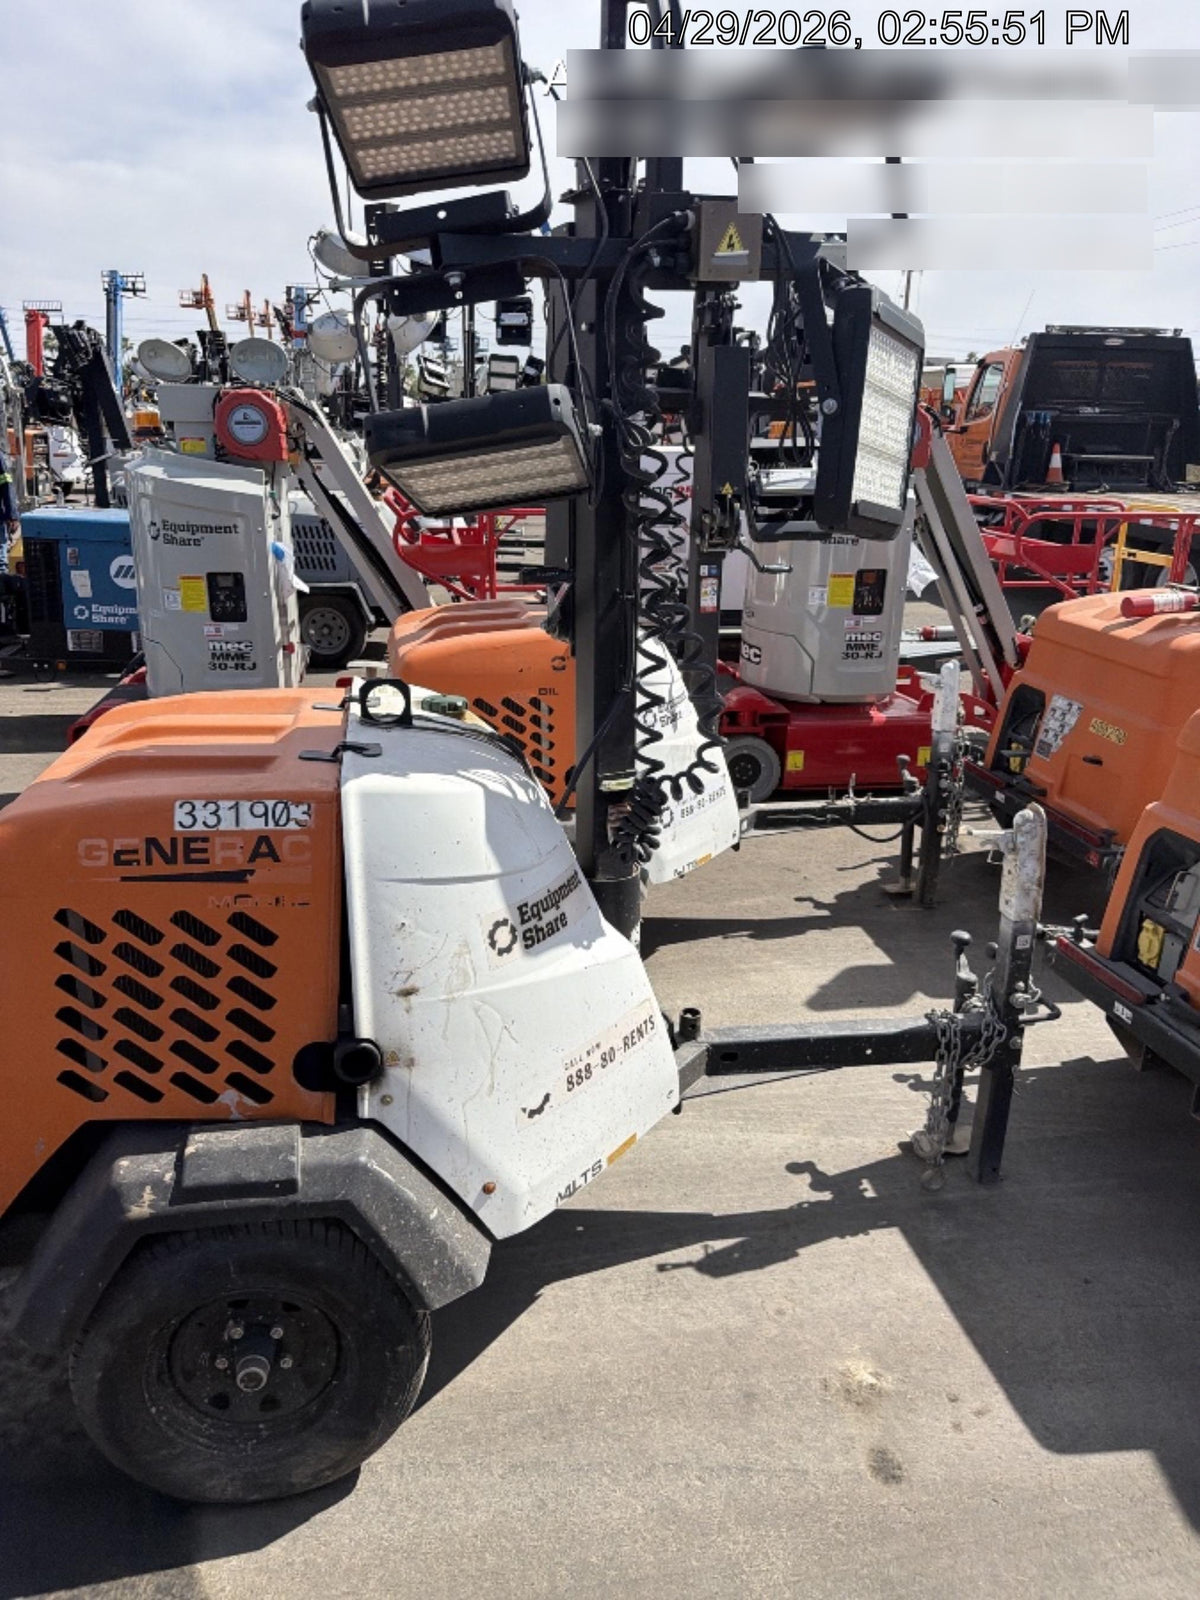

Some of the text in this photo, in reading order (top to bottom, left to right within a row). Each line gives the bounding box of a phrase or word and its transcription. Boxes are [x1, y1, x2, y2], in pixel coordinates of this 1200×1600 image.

[161, 519, 240, 536] Equipment
[162, 533, 202, 547] Share
[91, 613, 128, 624] Share
[845, 642, 879, 652] MME
[210, 652, 252, 662] MME
[207, 662, 257, 671] 30-RJ
[176, 801, 312, 829] 331903
[516, 869, 582, 926] Equipment
[522, 911, 568, 951] Share
